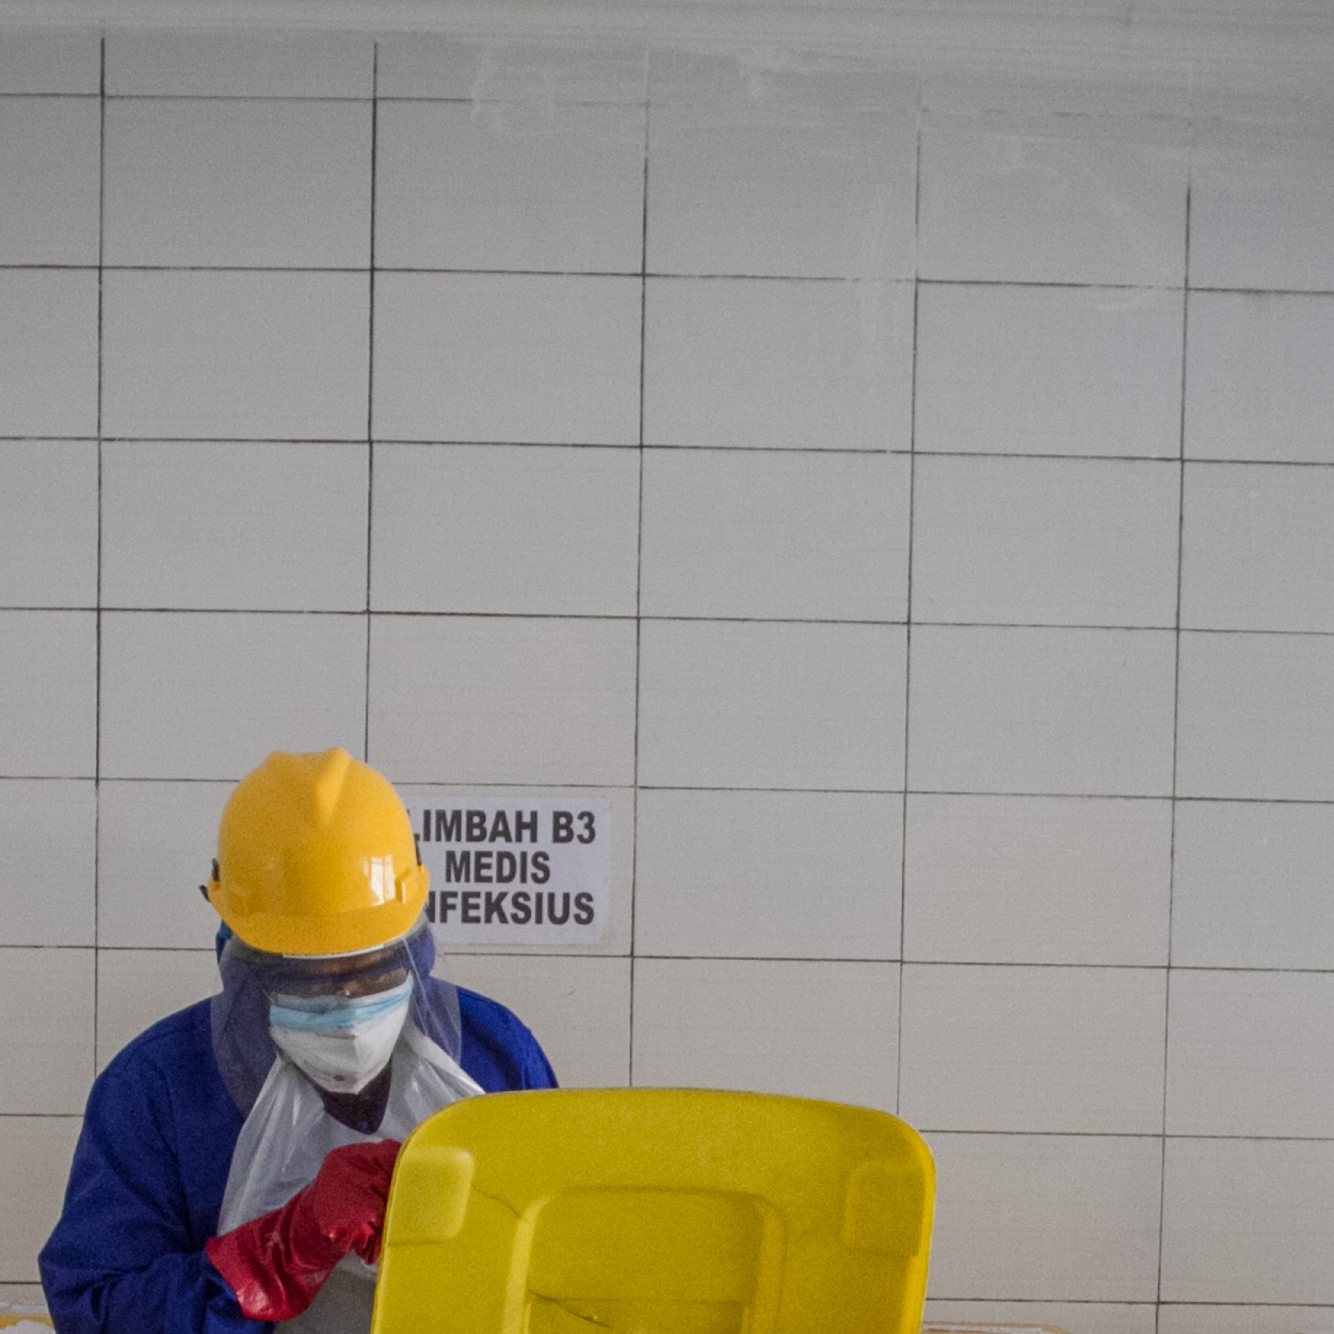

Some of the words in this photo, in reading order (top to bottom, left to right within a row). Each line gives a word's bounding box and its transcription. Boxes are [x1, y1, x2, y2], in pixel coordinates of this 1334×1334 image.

[408, 808, 538, 843] IMBAH
[552, 811, 596, 844] B3
[445, 850, 551, 884] MEDIS
